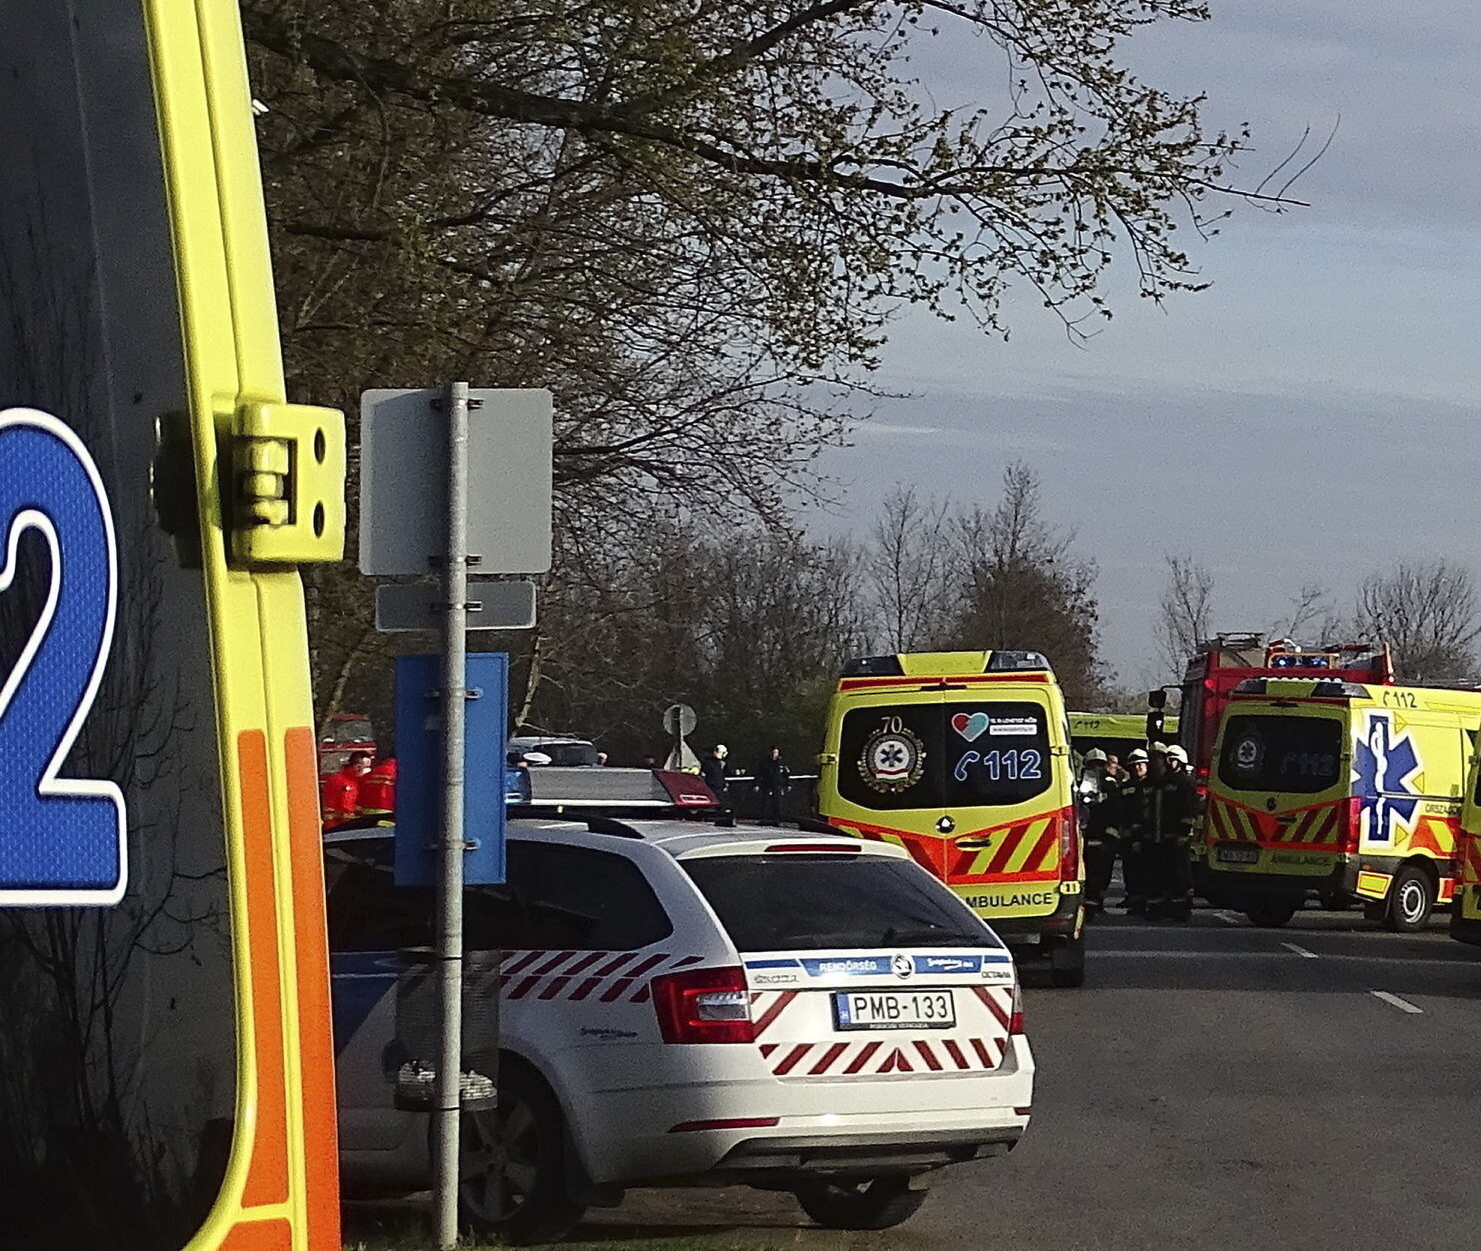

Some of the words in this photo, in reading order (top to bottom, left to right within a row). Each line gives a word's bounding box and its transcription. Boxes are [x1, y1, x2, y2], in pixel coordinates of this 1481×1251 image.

[1393, 692, 1417, 708] 112
[881, 715, 902, 733] 70
[984, 749, 1041, 780] 112
[965, 892, 1053, 908] MBULANCE
[853, 995, 949, 1021] PMB-133
